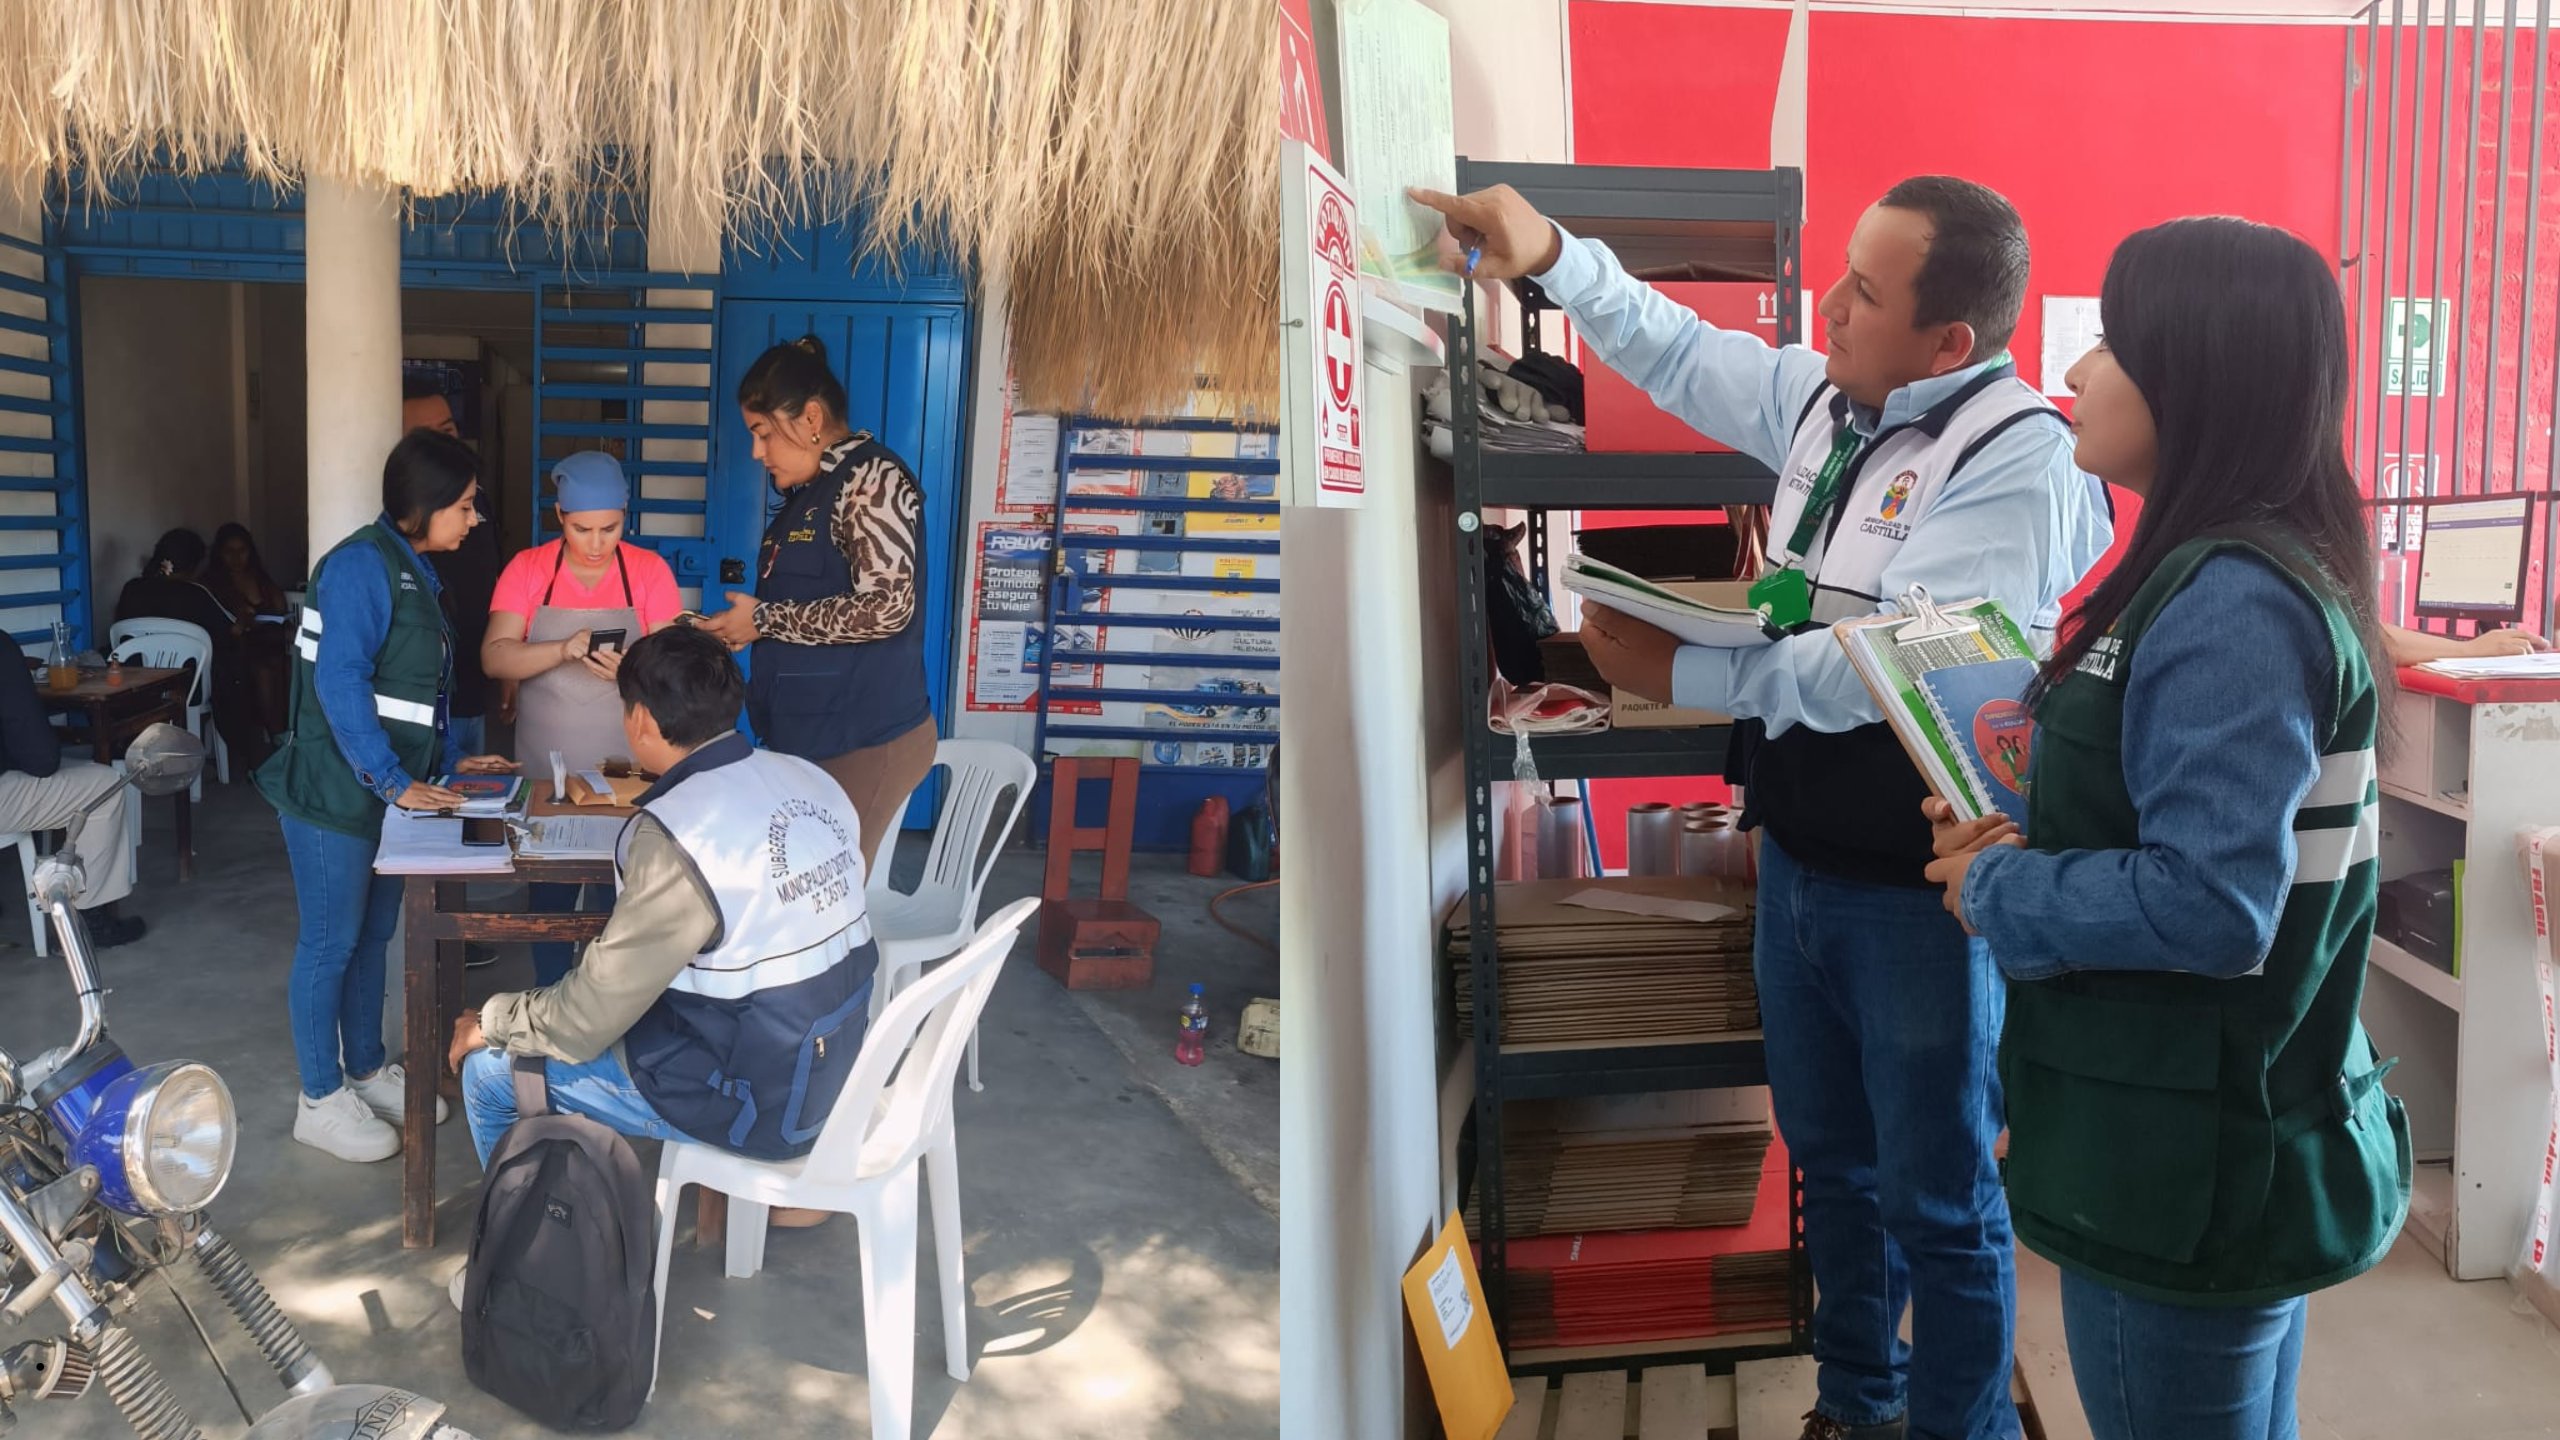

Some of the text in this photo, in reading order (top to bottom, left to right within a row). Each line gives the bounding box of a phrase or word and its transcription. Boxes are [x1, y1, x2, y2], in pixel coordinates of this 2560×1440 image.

[989, 567, 1039, 578] Protege
[986, 590, 1037, 601] asegura
[1000, 601, 1031, 611] viaje
[1621, 703, 1659, 711] PAQUETE
